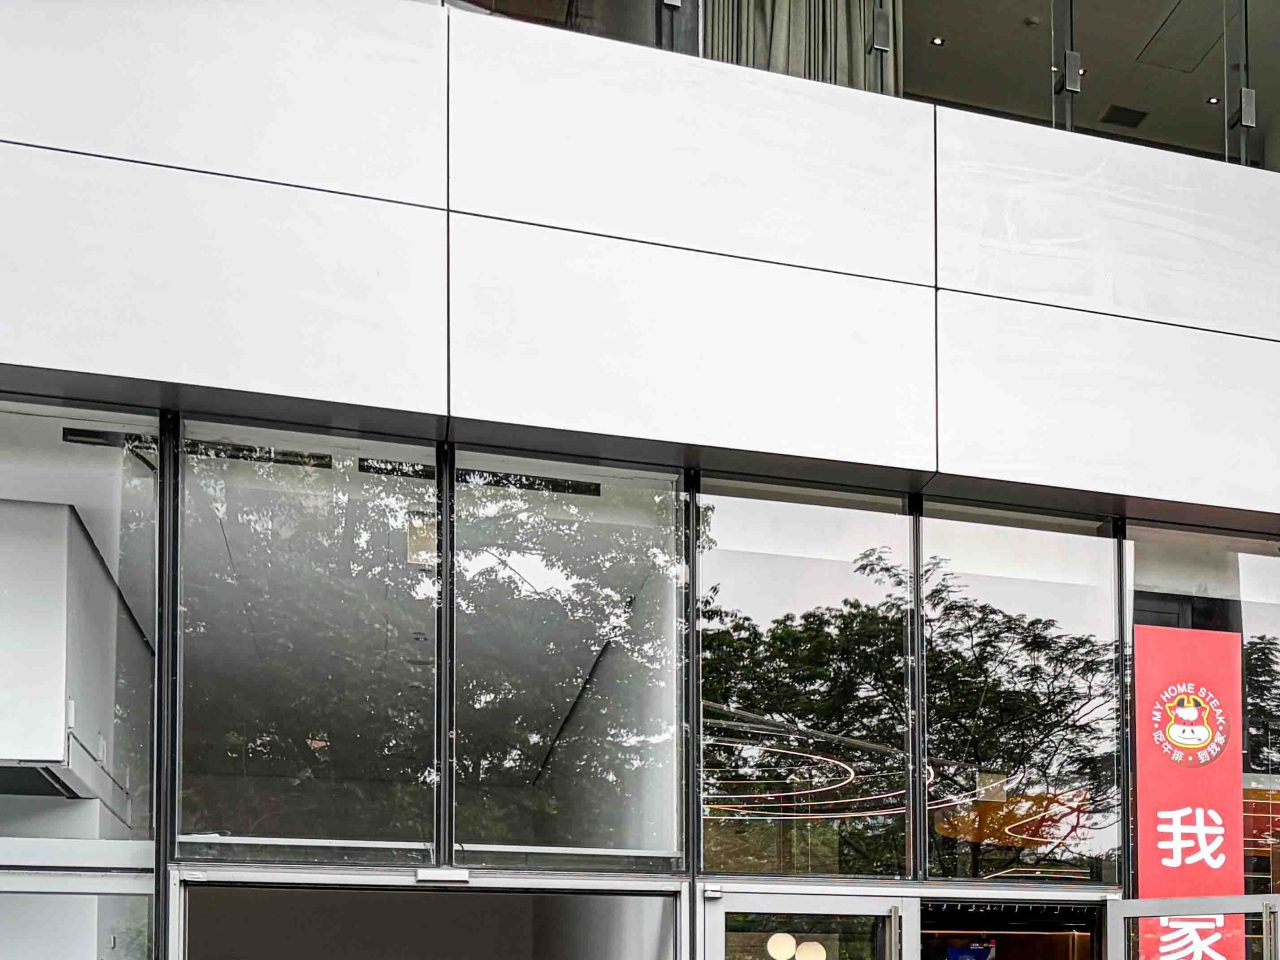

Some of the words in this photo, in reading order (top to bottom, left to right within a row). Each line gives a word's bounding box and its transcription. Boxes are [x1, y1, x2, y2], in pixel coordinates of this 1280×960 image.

[1152, 701, 1164, 722] MY
[1160, 682, 1195, 702] HOME
[1197, 687, 1226, 725] STEAK
